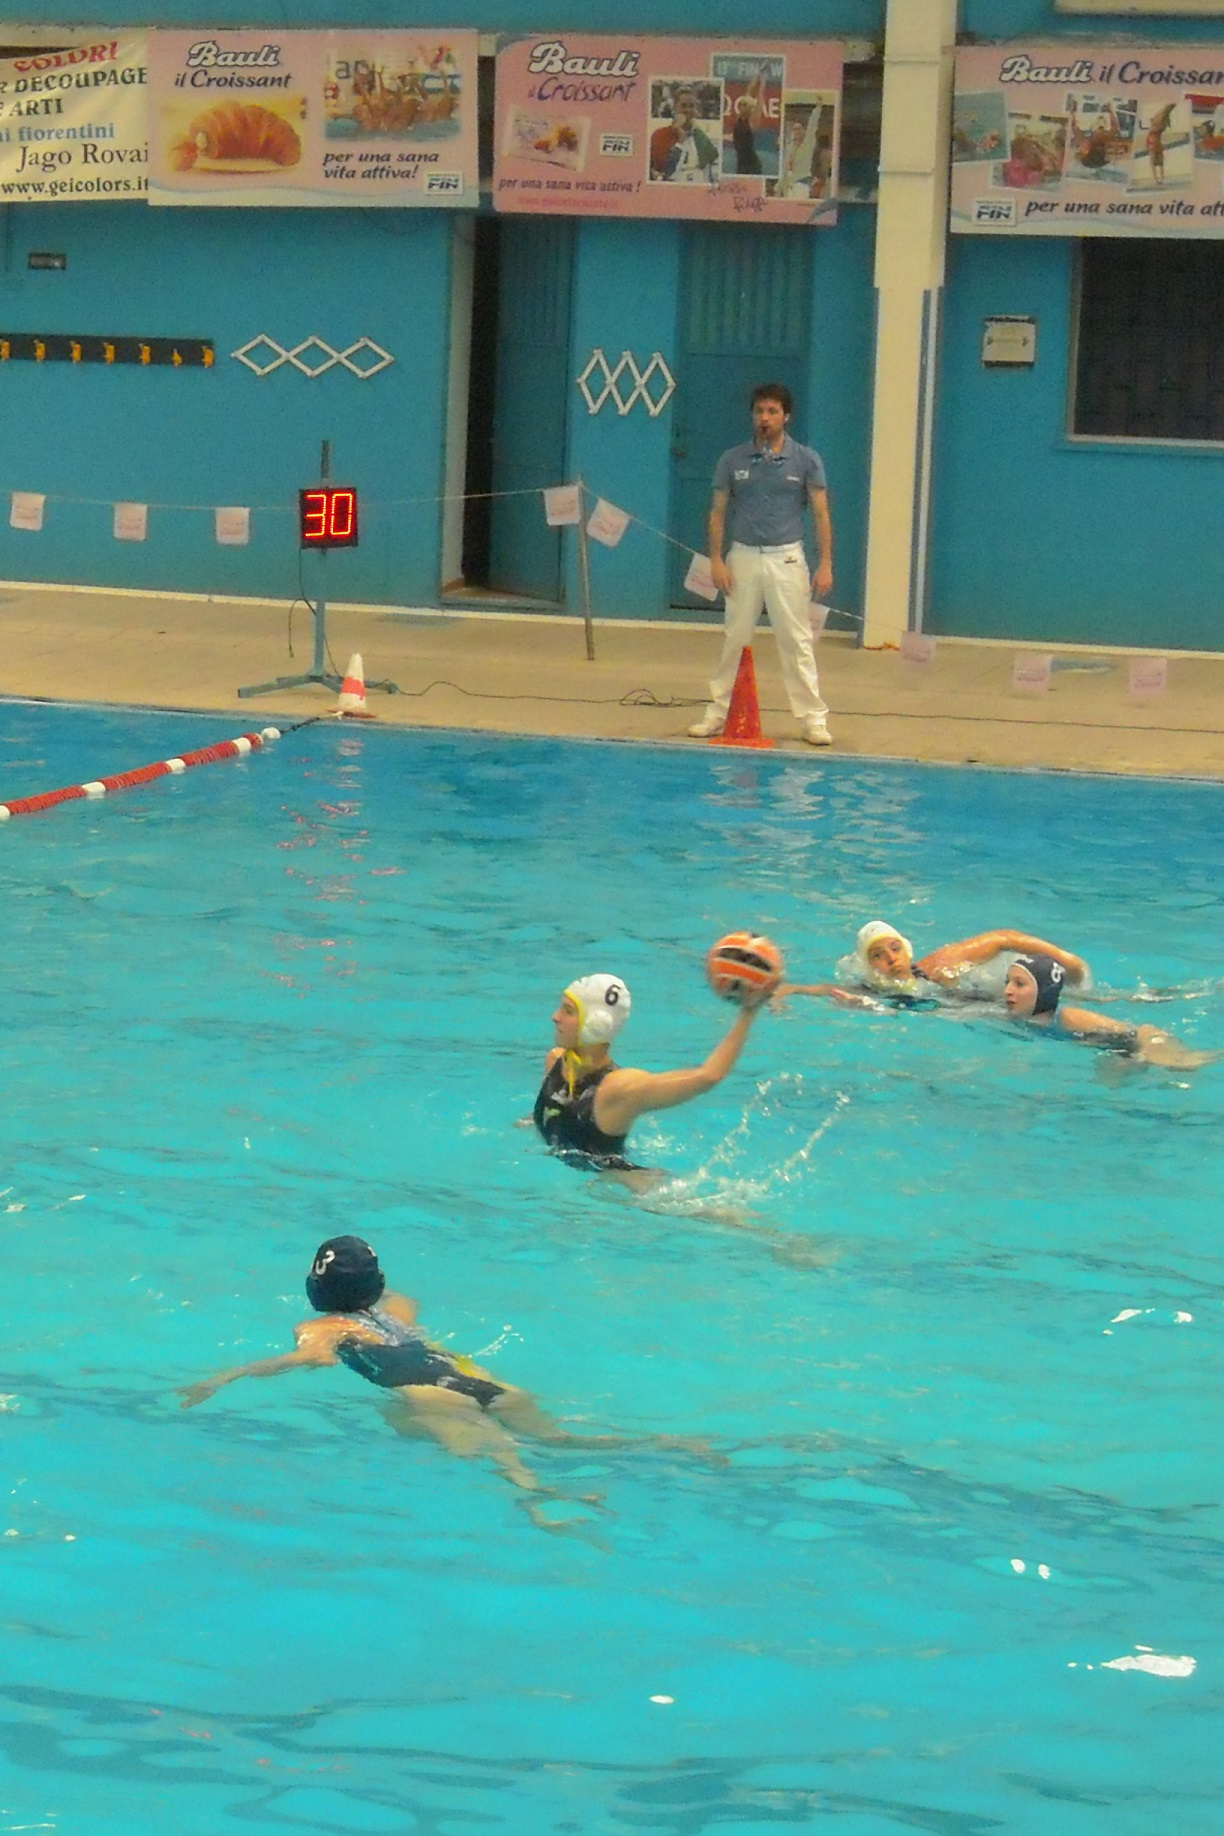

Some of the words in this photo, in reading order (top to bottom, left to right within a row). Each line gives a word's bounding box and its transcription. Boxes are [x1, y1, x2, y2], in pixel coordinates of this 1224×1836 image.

[13, 42, 118, 73] COLORI
[186, 40, 282, 68] Bauli
[527, 40, 641, 79] Bauli
[14, 67, 147, 93] DECOUPAGE
[174, 73, 187, 88] il
[190, 69, 293, 88] Croissant
[998, 54, 1095, 84] Bauli
[1099, 64, 1115, 84] il
[537, 76, 637, 102] Croissant
[9, 98, 63, 116] ARTI
[18, 122, 116, 142] fiorentini
[16, 145, 73, 173] Jago
[322, 152, 354, 166] per
[358, 152, 391, 163] una
[396, 152, 439, 163] sana
[324, 164, 357, 179] vita
[361, 164, 419, 179] attiva!
[1, 176, 149, 197] www.geicolors.it
[498, 178, 518, 191] per
[520, 179, 542, 189] una
[575, 180, 596, 191] vita
[1025, 200, 1058, 217] per
[1064, 202, 1099, 213] una
[1106, 203, 1153, 215] sana
[1160, 200, 1195, 216] vita
[305, 493, 353, 537] 30
[604, 984, 622, 1006] 6
